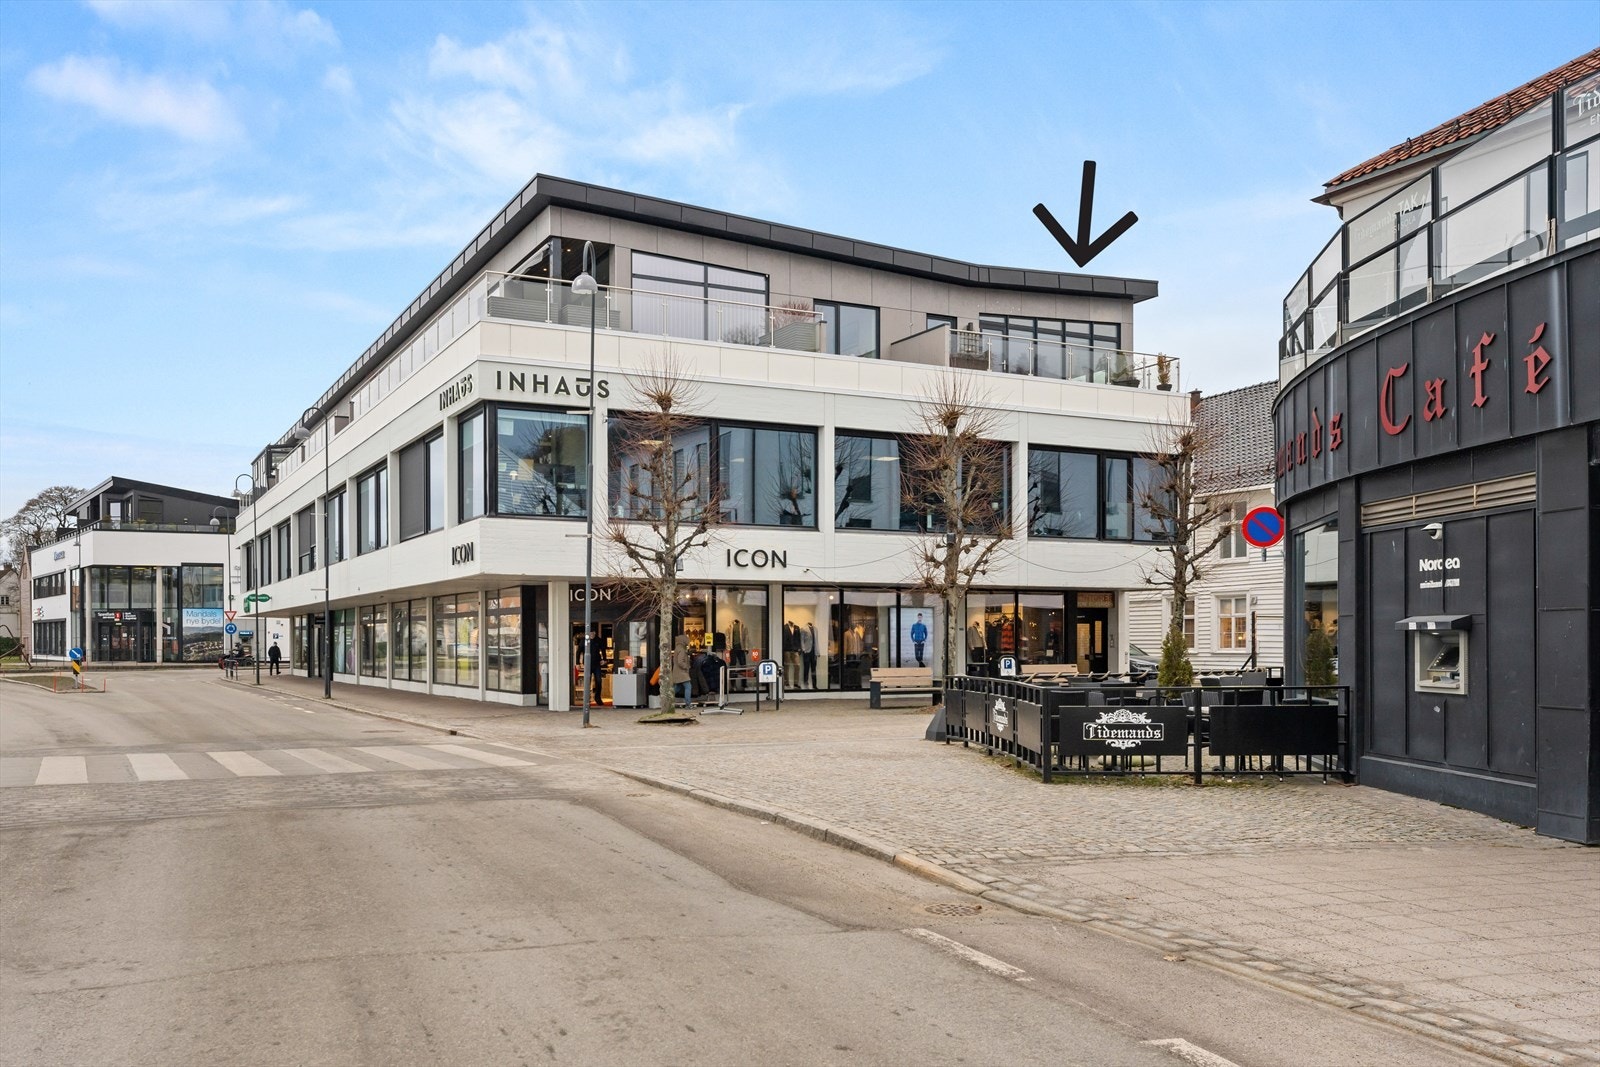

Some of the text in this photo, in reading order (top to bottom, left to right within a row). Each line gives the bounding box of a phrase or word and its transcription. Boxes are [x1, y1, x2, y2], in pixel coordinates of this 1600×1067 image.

[1380, 322, 1552, 435] Café
[451, 541, 474, 565] ICON
[726, 548, 787, 568] ICON
[570, 588, 612, 602] ICON
[186, 610, 217, 618] Mandals
[1086, 724, 1162, 739] Tidemands
